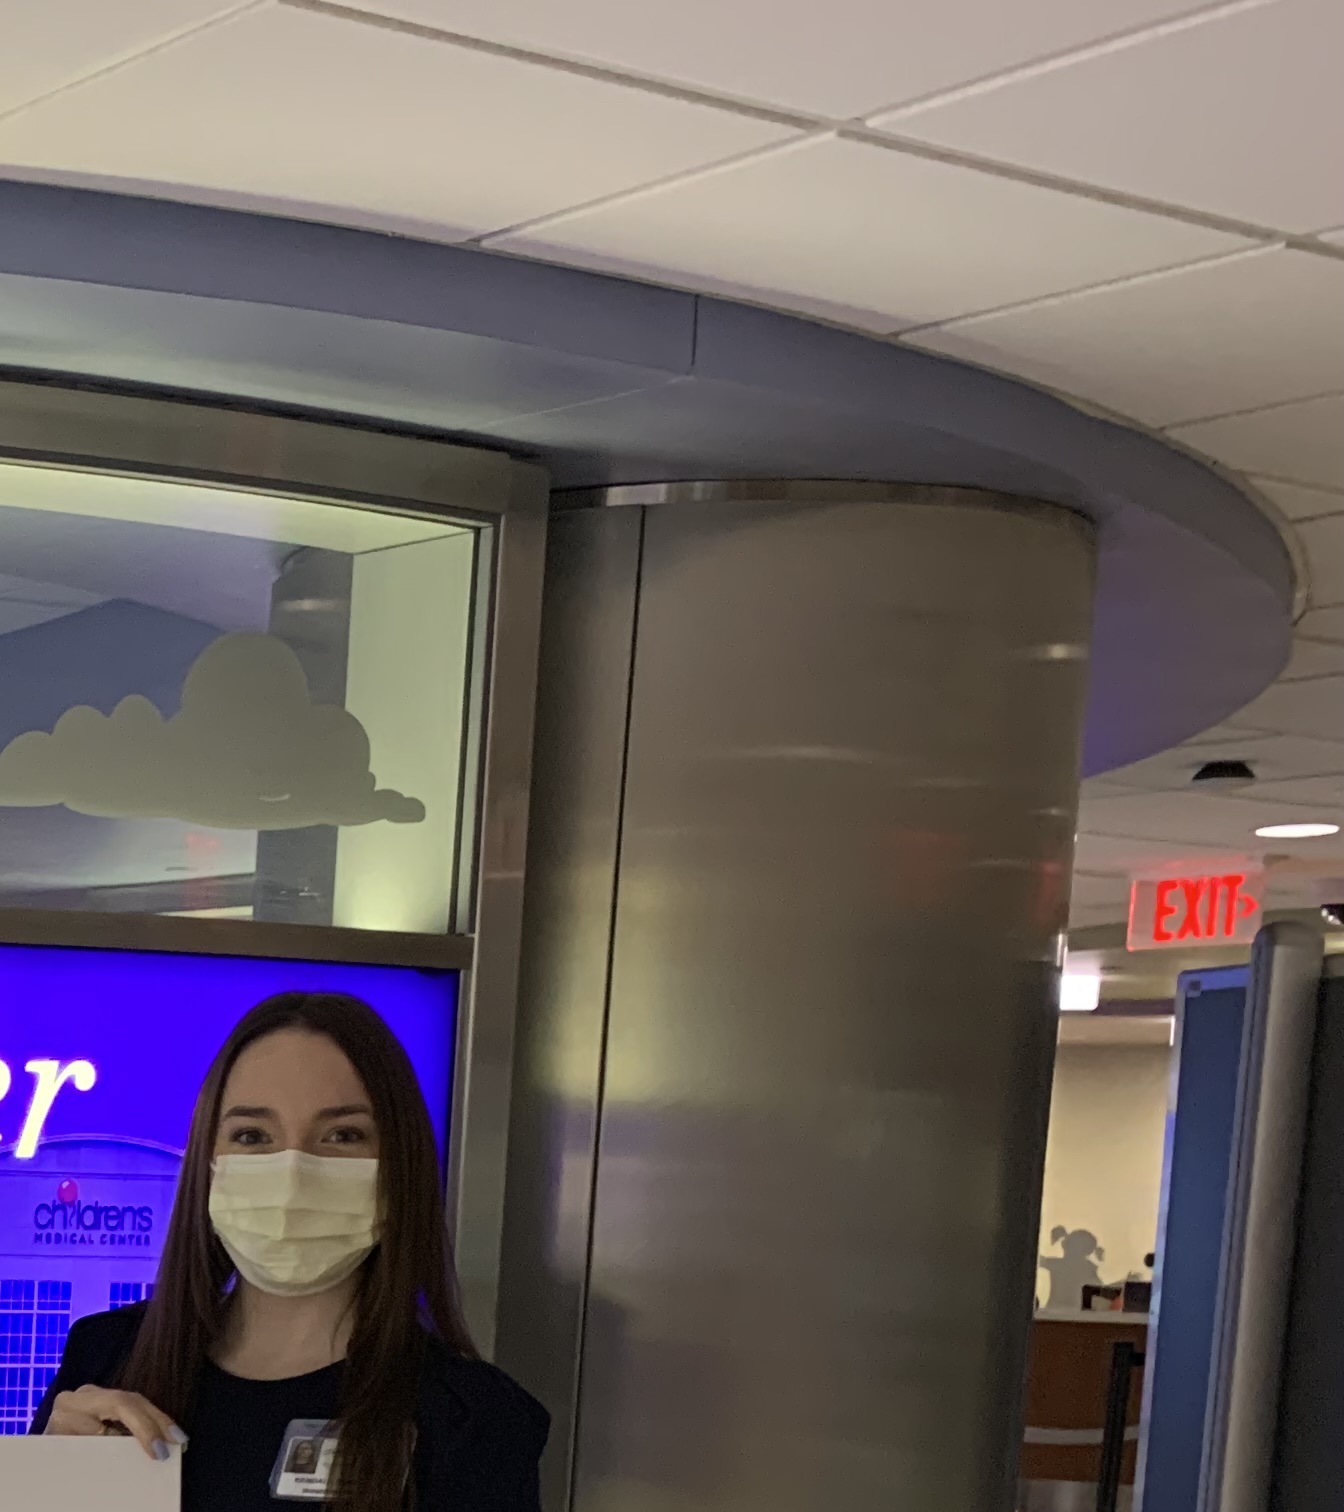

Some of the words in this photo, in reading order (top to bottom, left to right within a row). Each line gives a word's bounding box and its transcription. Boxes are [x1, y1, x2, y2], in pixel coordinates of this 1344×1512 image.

[1153, 874, 1246, 942] EXIT
[34, 1232, 95, 1245] MEDICAL
[100, 1233, 151, 1246] CENTER
